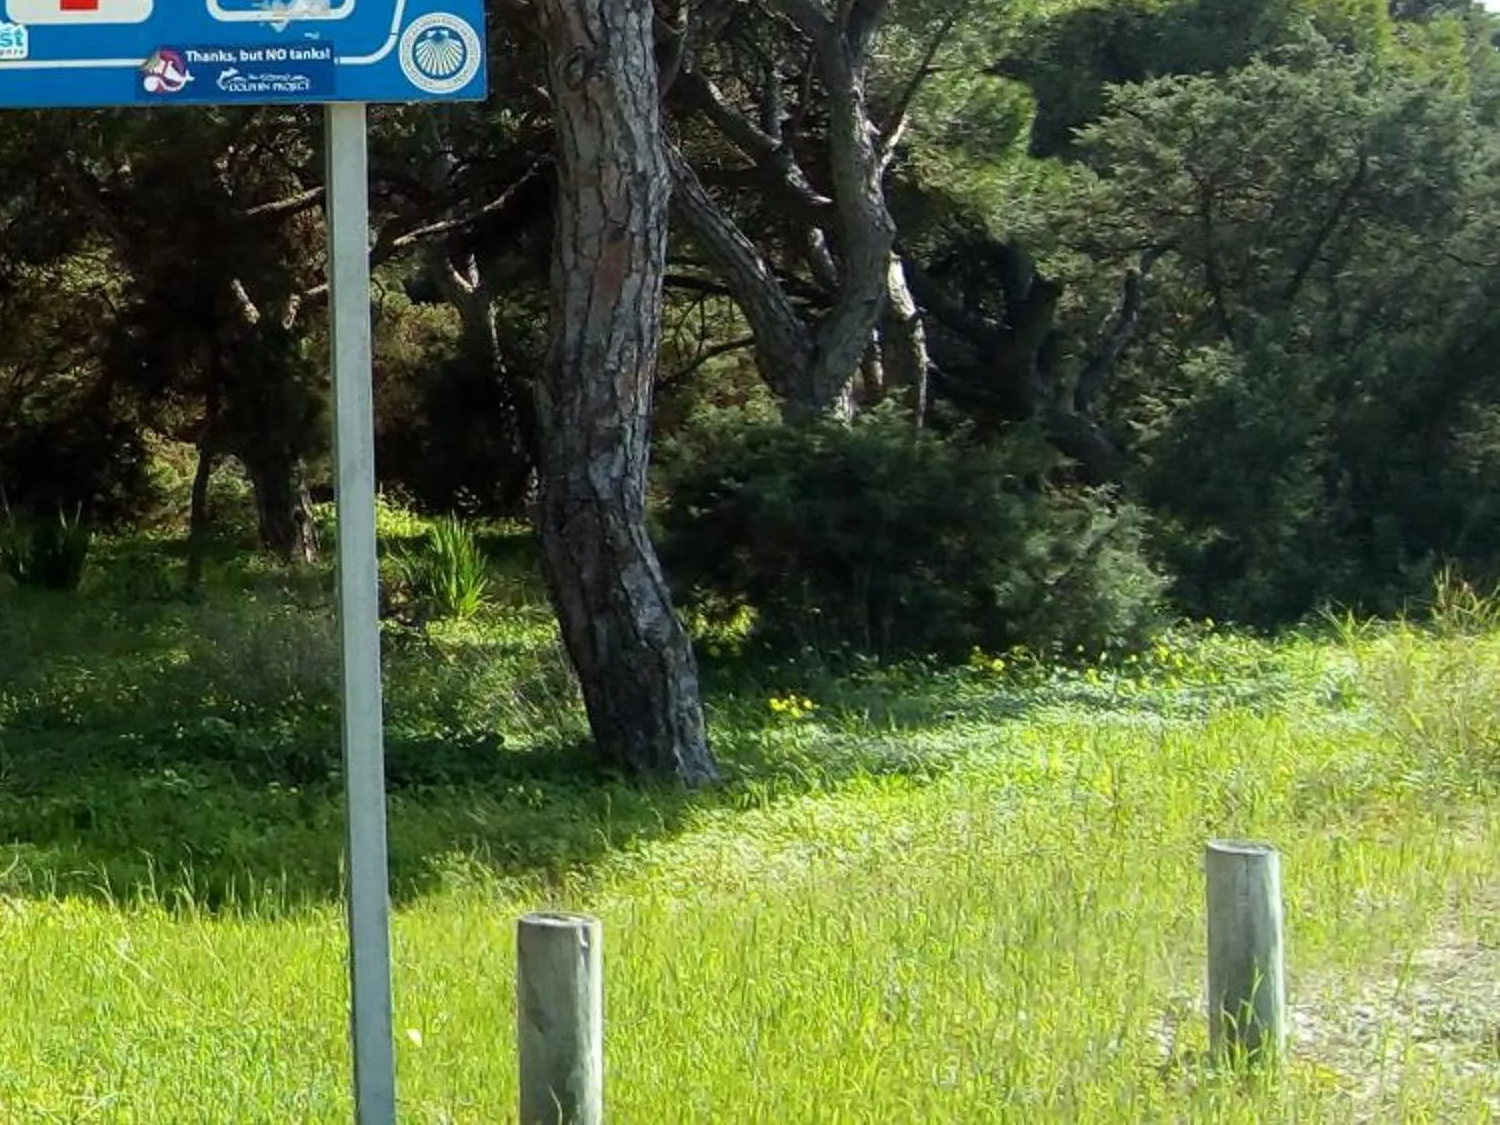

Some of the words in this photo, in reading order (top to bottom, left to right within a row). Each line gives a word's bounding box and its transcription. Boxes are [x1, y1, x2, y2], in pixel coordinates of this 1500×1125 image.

[186, 50, 237, 64] Thanks,
[239, 49, 263, 62] but
[265, 48, 287, 61] NO
[290, 47, 331, 60] tanks!
